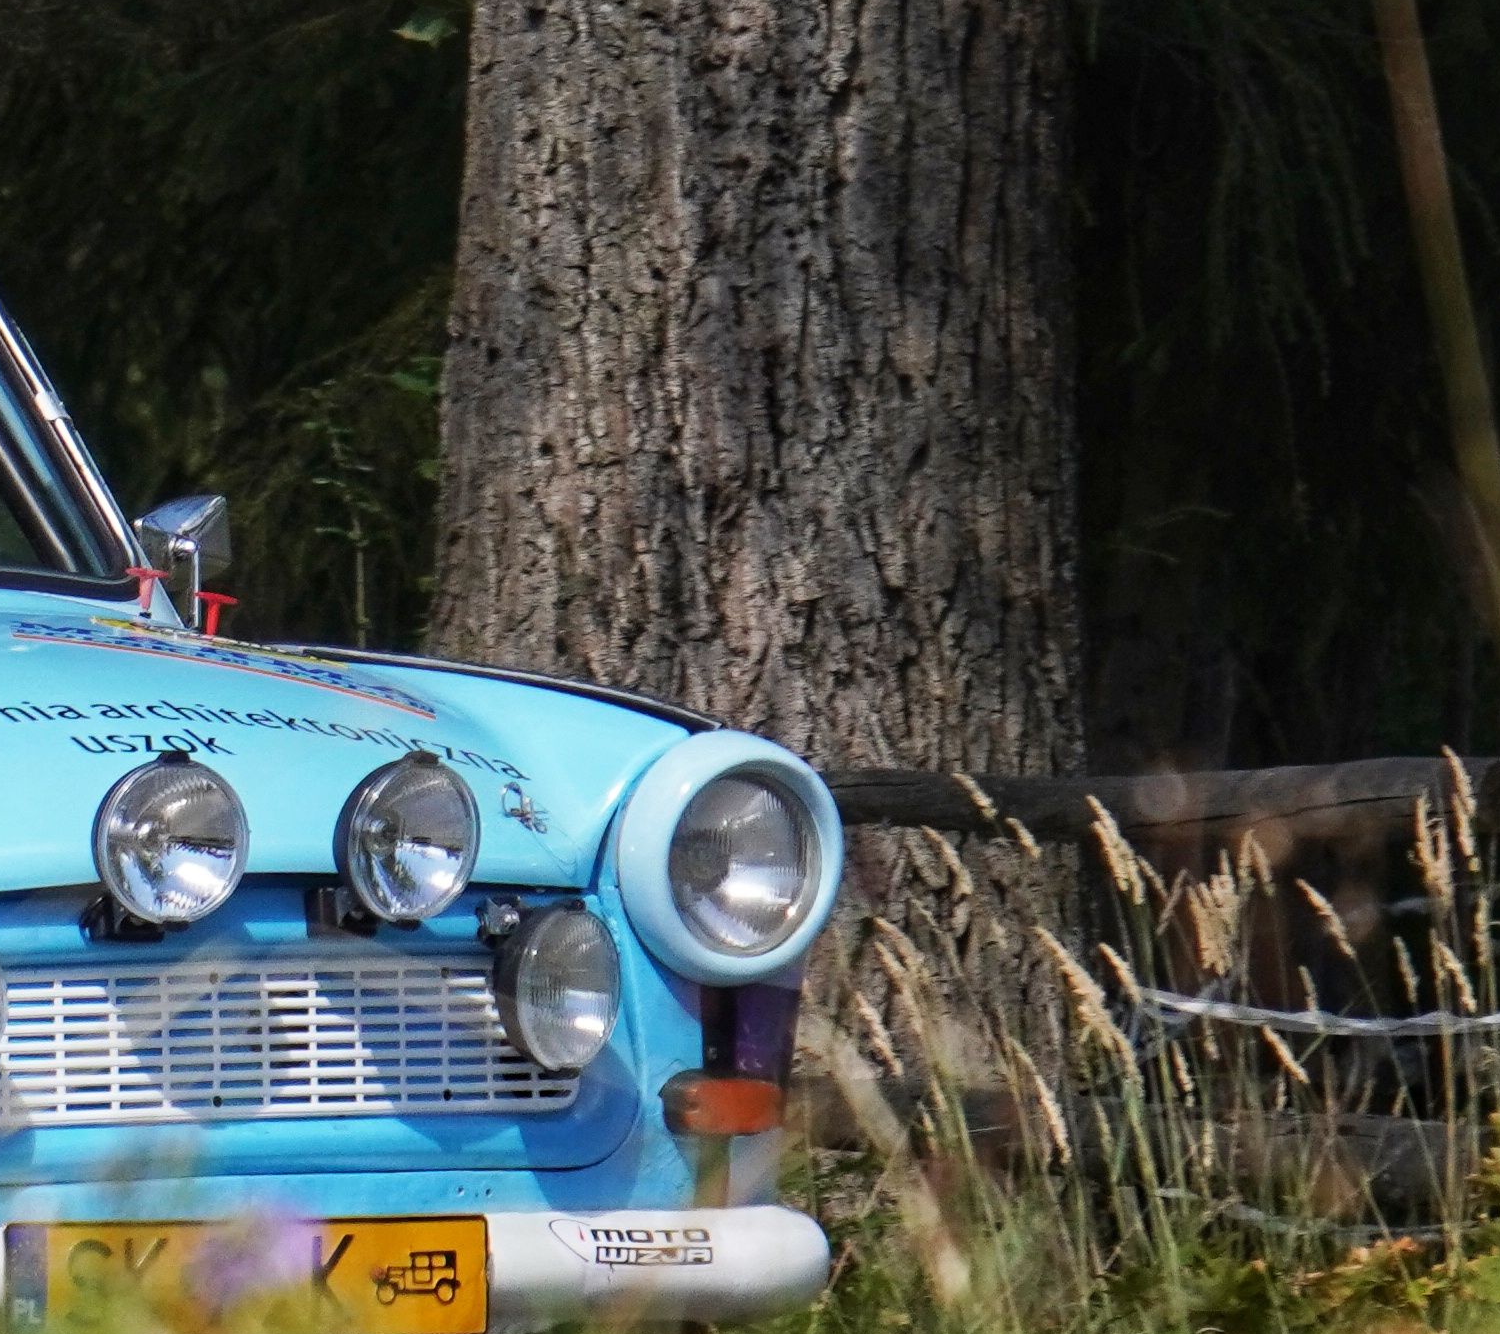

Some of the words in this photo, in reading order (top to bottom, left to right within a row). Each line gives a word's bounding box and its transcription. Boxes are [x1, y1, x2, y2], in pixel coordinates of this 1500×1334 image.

[70, 728, 238, 757] uszok
[89, 699, 531, 781] architektoniczna
[590, 1228, 711, 1243] MOTO
[597, 1246, 713, 1265] WIZJA
